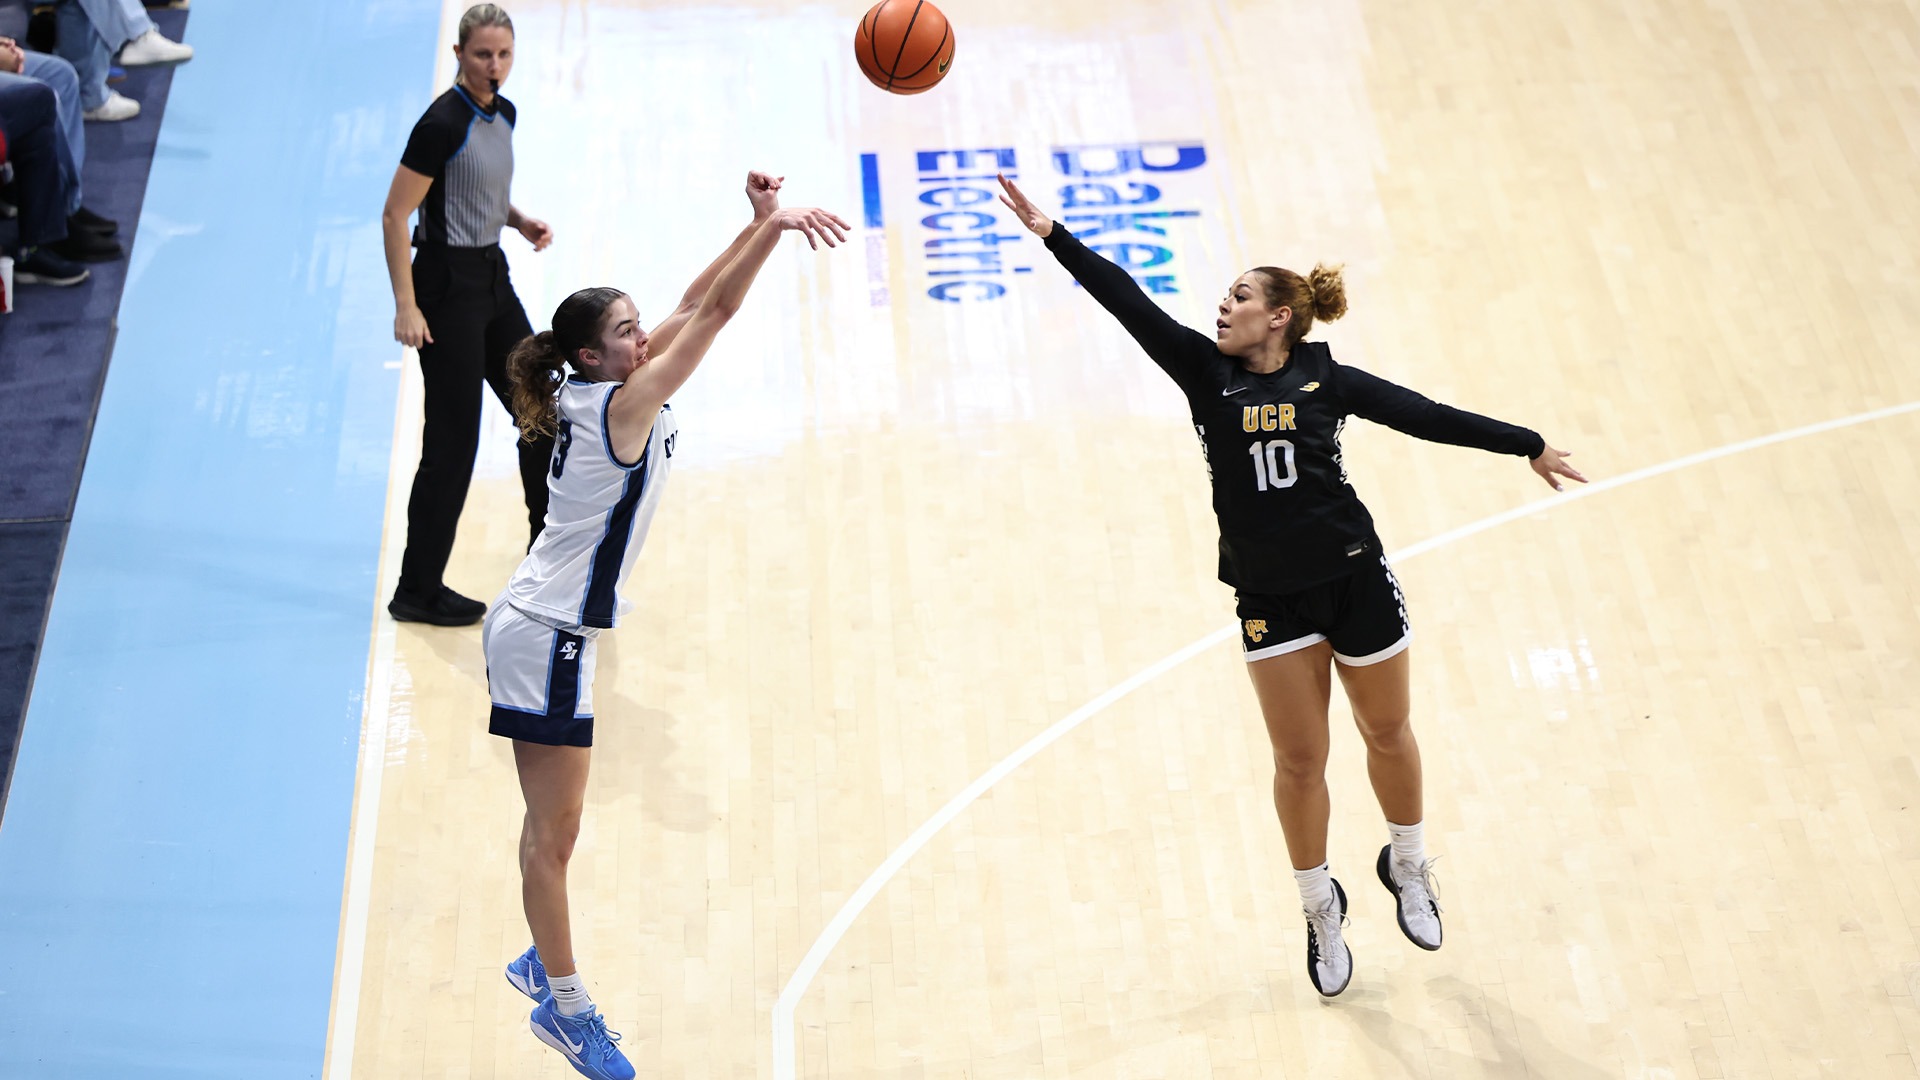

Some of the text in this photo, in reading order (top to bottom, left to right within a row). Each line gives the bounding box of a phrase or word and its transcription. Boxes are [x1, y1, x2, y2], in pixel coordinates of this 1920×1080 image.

[915, 148, 1032, 302] Electric
[1242, 403, 1297, 433] UCR
[1249, 439, 1299, 492] 10
